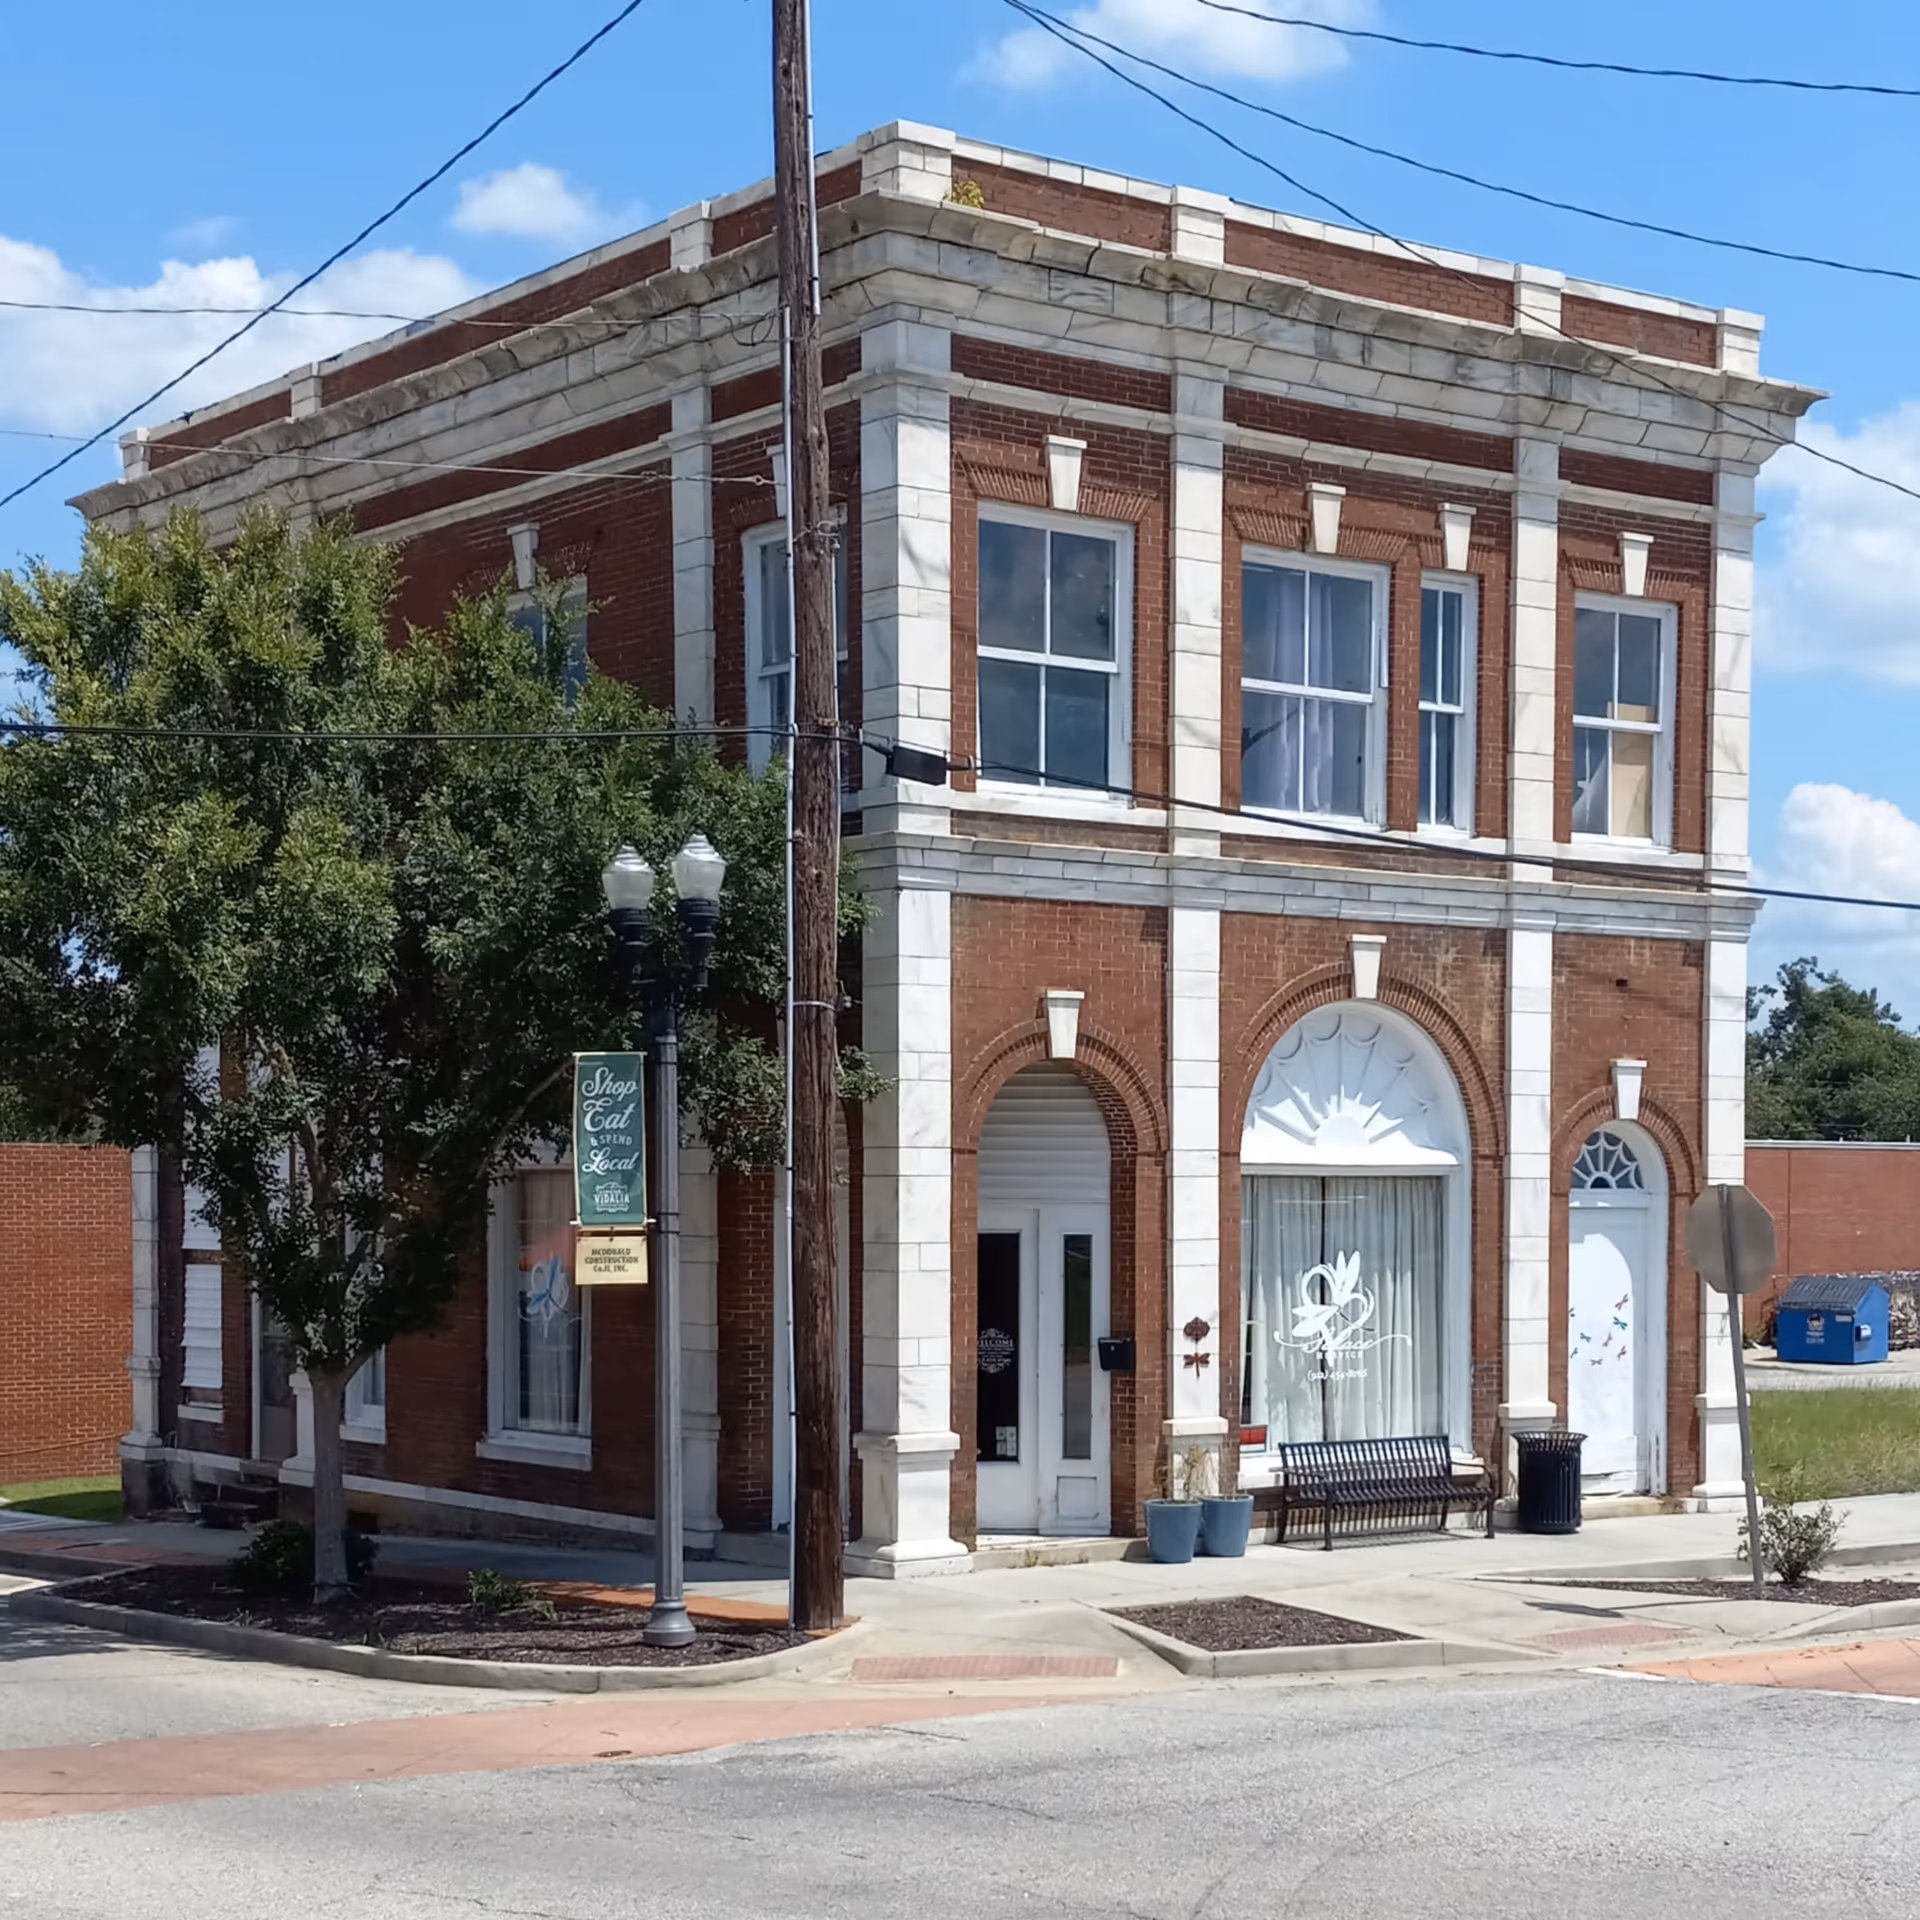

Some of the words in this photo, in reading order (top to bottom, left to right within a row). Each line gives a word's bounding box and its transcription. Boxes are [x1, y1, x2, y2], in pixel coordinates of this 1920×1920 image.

[581, 1066, 638, 1102] Shop
[583, 1097, 635, 1132] Eat
[590, 1136, 598, 1146] &
[599, 1134, 632, 1146] SPEND
[581, 1147, 640, 1176] Local
[593, 1194, 630, 1204] VIDALIA
[584, 1256, 639, 1264] CONSTRUCTION
[978, 1339, 1014, 1347] ELCOME
